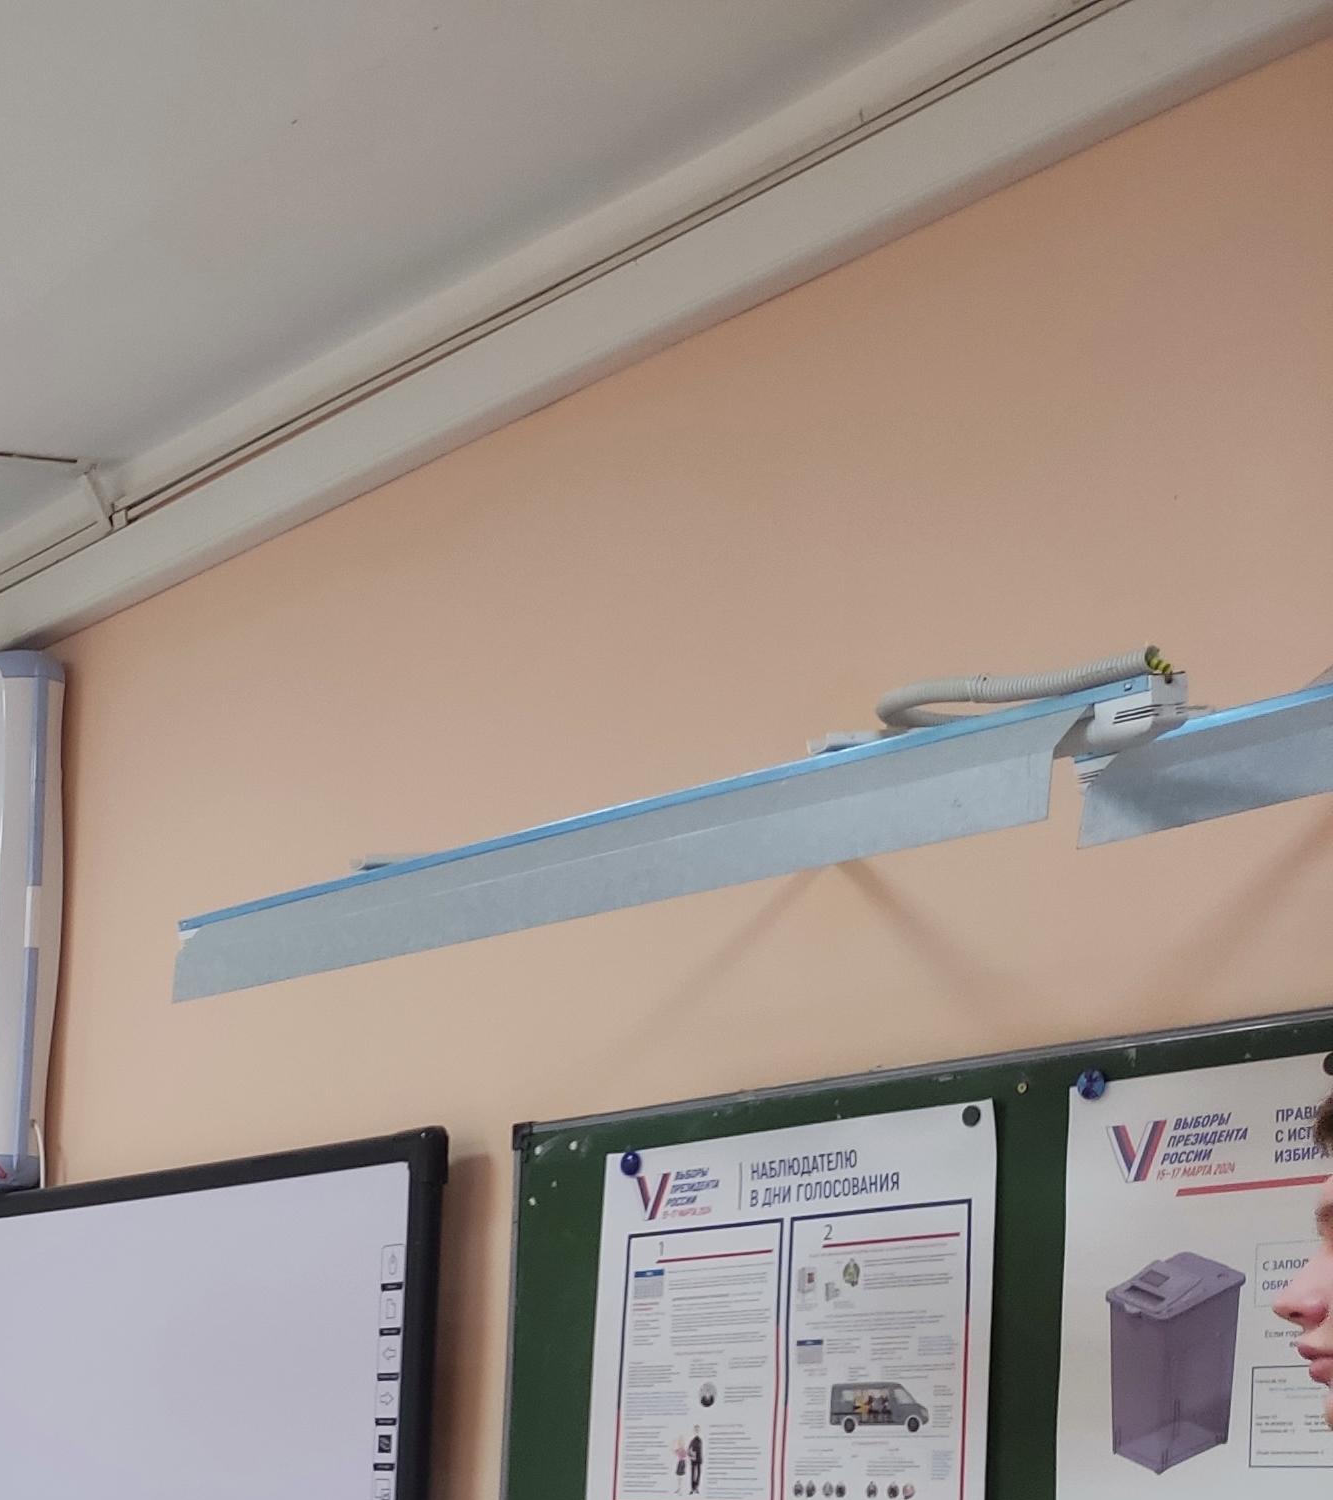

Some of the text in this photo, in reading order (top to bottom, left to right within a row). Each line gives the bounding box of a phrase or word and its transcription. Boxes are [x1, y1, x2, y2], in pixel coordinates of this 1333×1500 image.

[1173, 1112, 1232, 1131] ВЫБОРЫ
[1167, 1127, 1248, 1148] ПРЕЗИДЕНТА
[1275, 1131, 1284, 1144] С
[751, 1149, 858, 1181] НАБЛЮДАТЕЛЮ
[1161, 1149, 1213, 1165] РОССИИ
[1182, 1165, 1212, 1177] МАРТА
[1213, 1162, 1236, 1175] 2024
[749, 1171, 900, 1208] В ДНИ ГОЛОСОВАНИЯ
[822, 1224, 834, 1241] 2
[658, 1241, 665, 1256] 1
[1262, 1261, 1270, 1272] С
